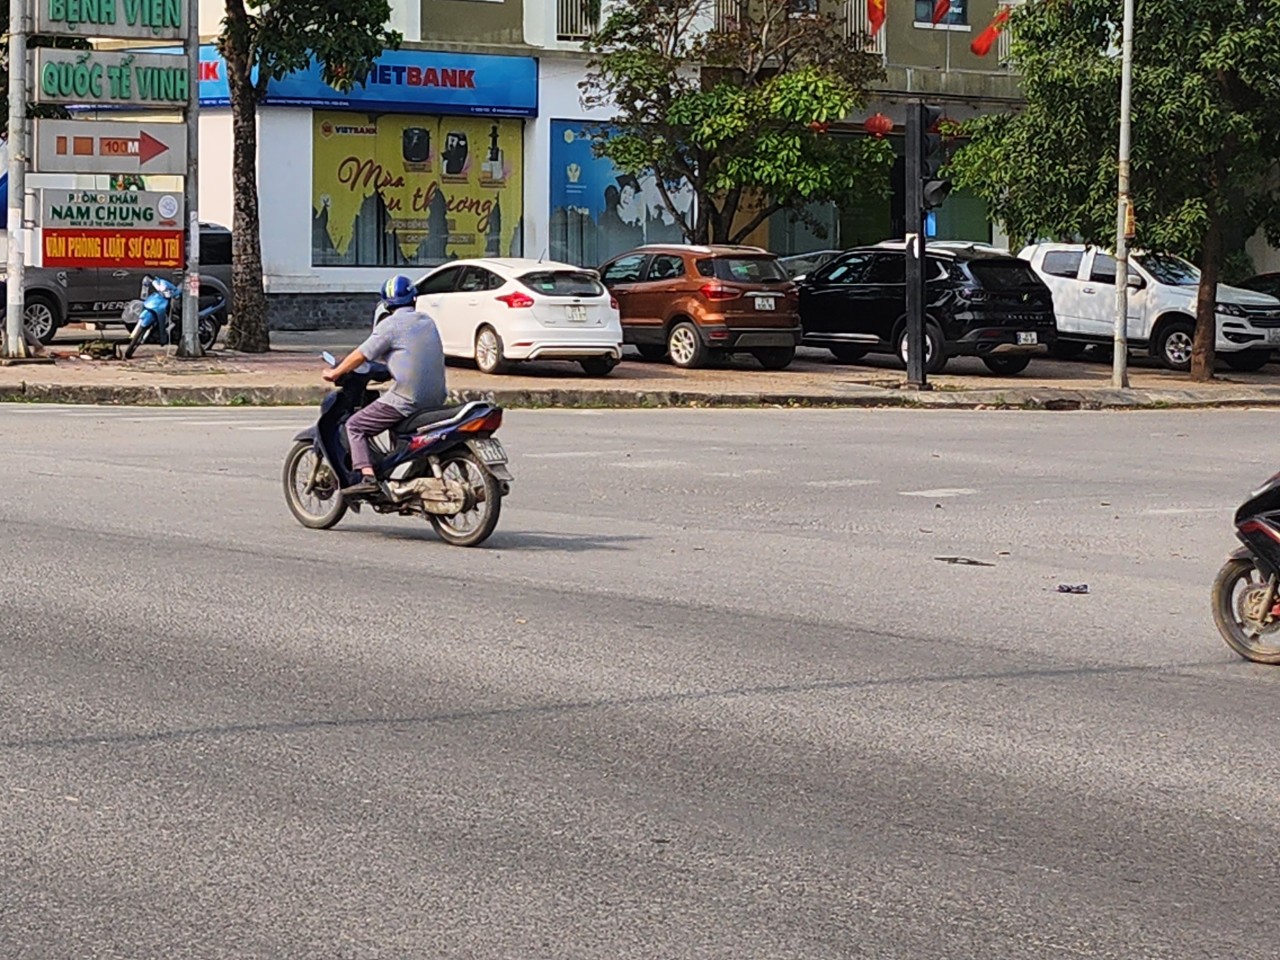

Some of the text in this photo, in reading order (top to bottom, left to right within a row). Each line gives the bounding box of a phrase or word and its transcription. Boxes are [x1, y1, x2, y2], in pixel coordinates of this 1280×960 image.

[42, 52, 103, 98] QUỐC
[107, 55, 135, 99] TẾ
[136, 66, 189, 101] VINH
[370, 65, 476, 89] IETBANK
[105, 141, 139, 154] 100M
[68, 190, 138, 205] PHÒNG KHÁM
[51, 205, 154, 222] NAM CHUNG
[46, 233, 180, 262] VĂN PHÒNG LUẬT SƯ CAO TRÍ
